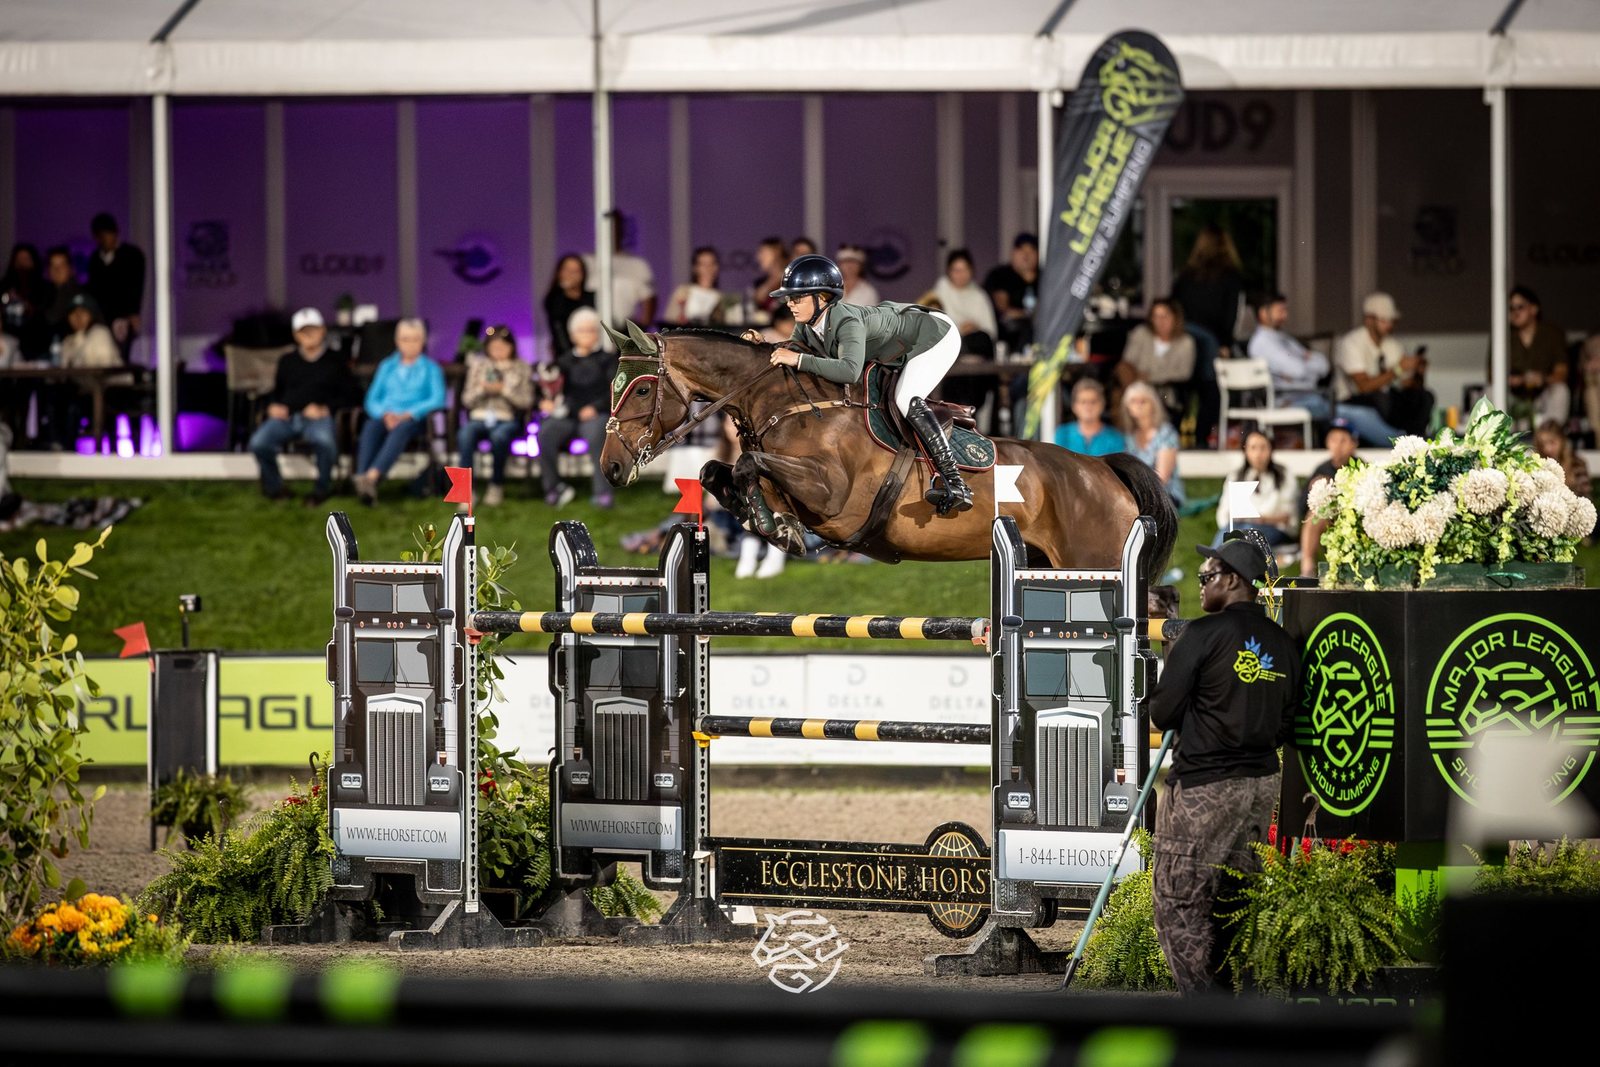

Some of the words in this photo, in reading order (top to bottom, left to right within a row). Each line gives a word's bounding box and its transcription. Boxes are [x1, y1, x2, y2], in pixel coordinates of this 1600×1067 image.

[1060, 118, 1118, 228] MAJOR
[1069, 128, 1137, 255] LEAGUE
[1070, 232, 1109, 300] SHOW
[1100, 137, 1152, 239] JUMPING
[1302, 631, 1340, 708] MAJOR
[1342, 629, 1386, 711] LEAGUE
[1440, 631, 1506, 712] MAJOR
[1513, 630, 1588, 710] LEAGUE
[731, 695, 789, 709] DELTA
[827, 694, 885, 708] DELTA
[928, 695, 987, 709] DELTA
[1309, 755, 1335, 797] SHOW
[1336, 756, 1380, 801] JUMPING
[346, 826, 447, 843] WWW.EHORSET.COM
[570, 819, 673, 836] WWW.EHORSET.COM
[1019, 847, 1117, 867] 1-844-EHORSE
[761, 860, 907, 892] ECCLESTONE
[921, 867, 991, 895] HORS
